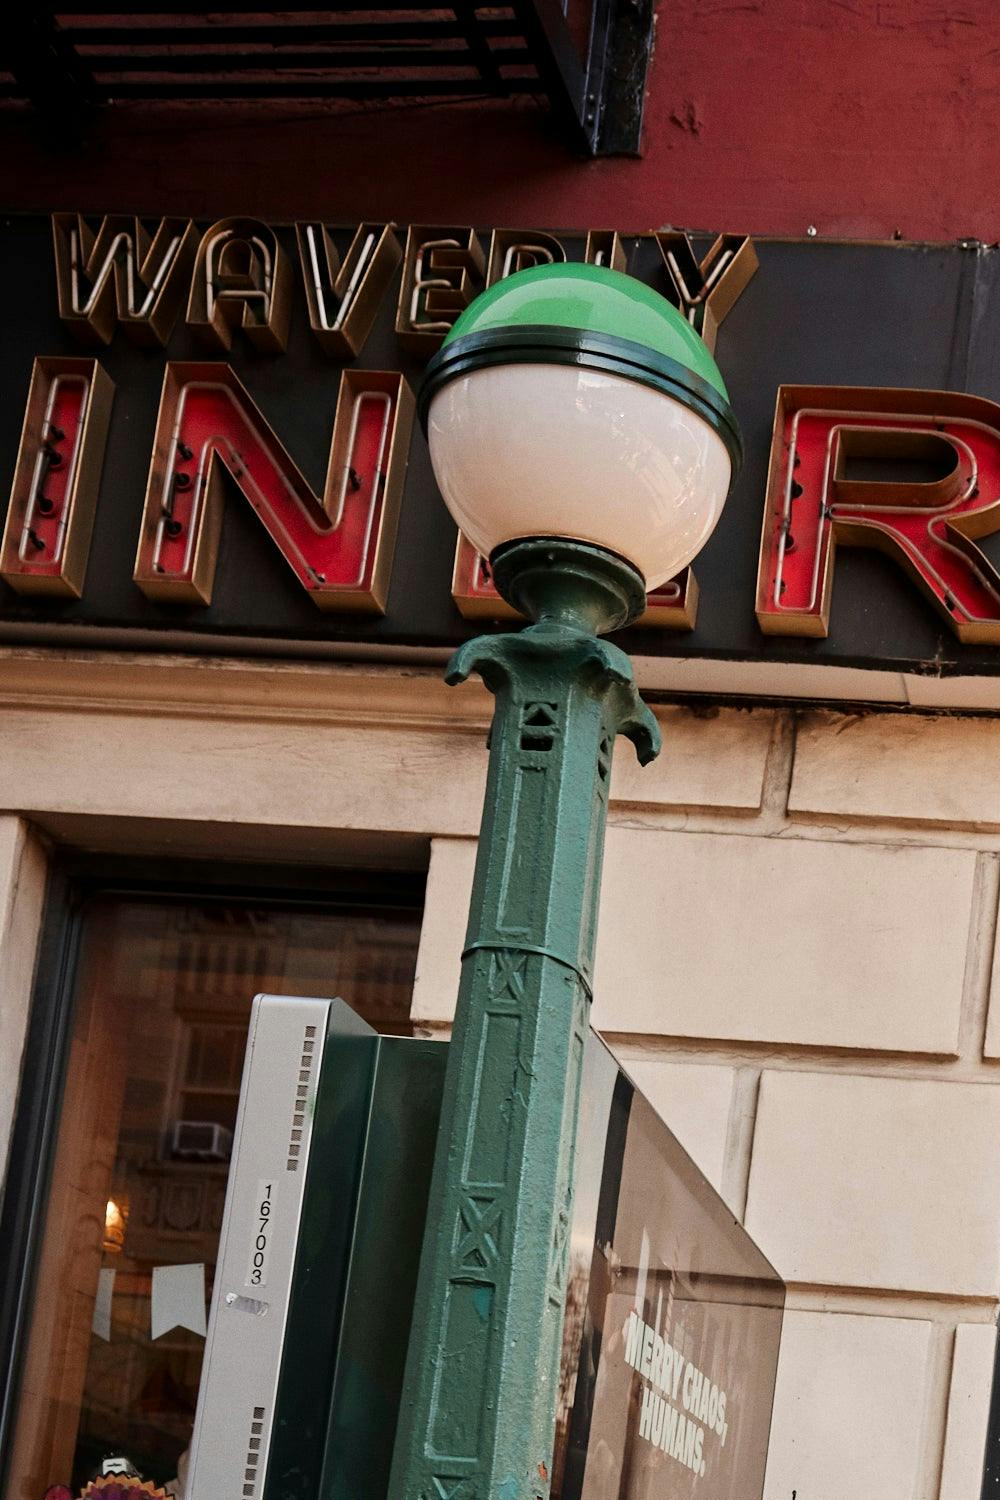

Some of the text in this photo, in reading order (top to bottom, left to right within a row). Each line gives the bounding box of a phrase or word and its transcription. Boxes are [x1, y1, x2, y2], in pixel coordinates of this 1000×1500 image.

[51, 212, 759, 358] WAVEY
[251, 1184, 272, 1285] 167003
[624, 1311, 728, 1448] MERRY CHAOS,
[638, 1386, 706, 1478] HUMANS.
